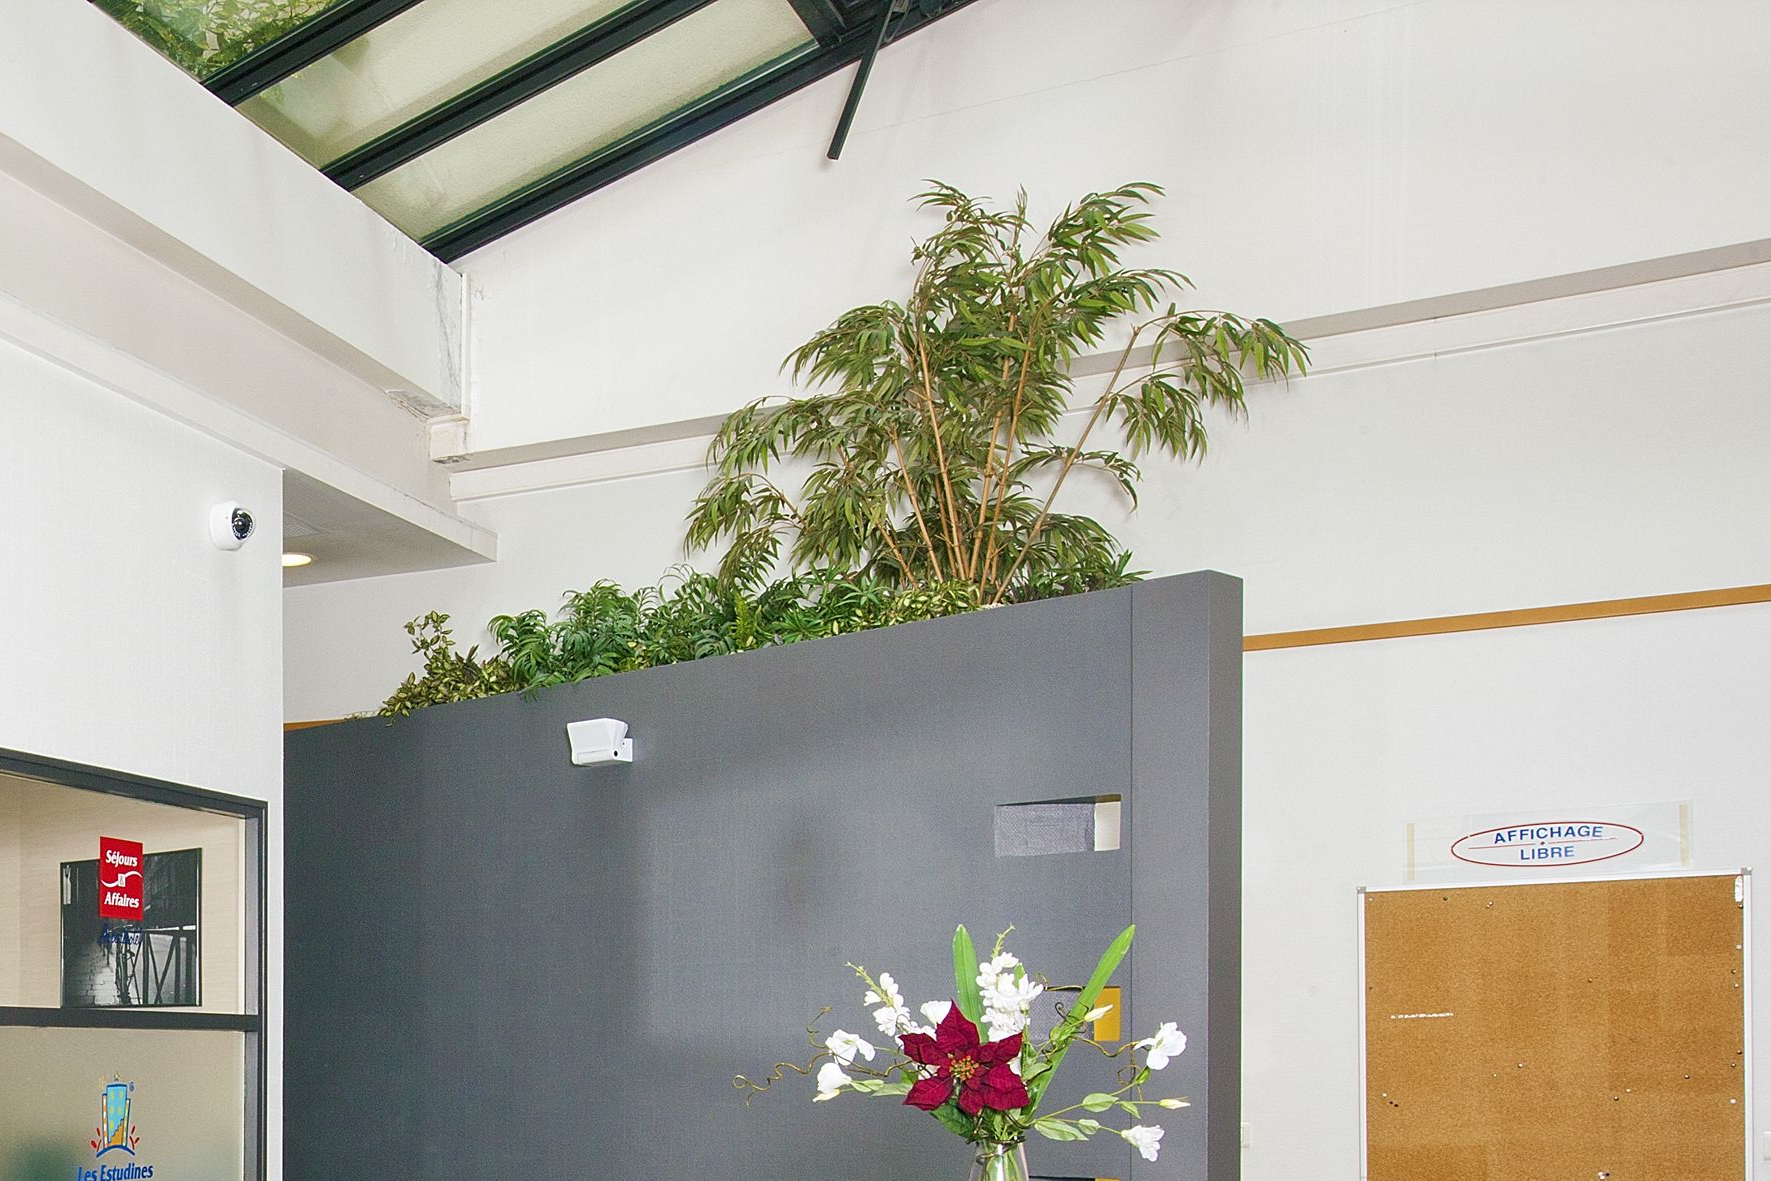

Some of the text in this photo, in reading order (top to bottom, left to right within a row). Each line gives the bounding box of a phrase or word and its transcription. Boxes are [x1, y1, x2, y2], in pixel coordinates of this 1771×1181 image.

[1493, 825, 1604, 844] AFFICHAGE
[106, 850, 138, 867] Séjours
[1520, 846, 1575, 860] LIBRE
[104, 891, 140, 908] Affaires
